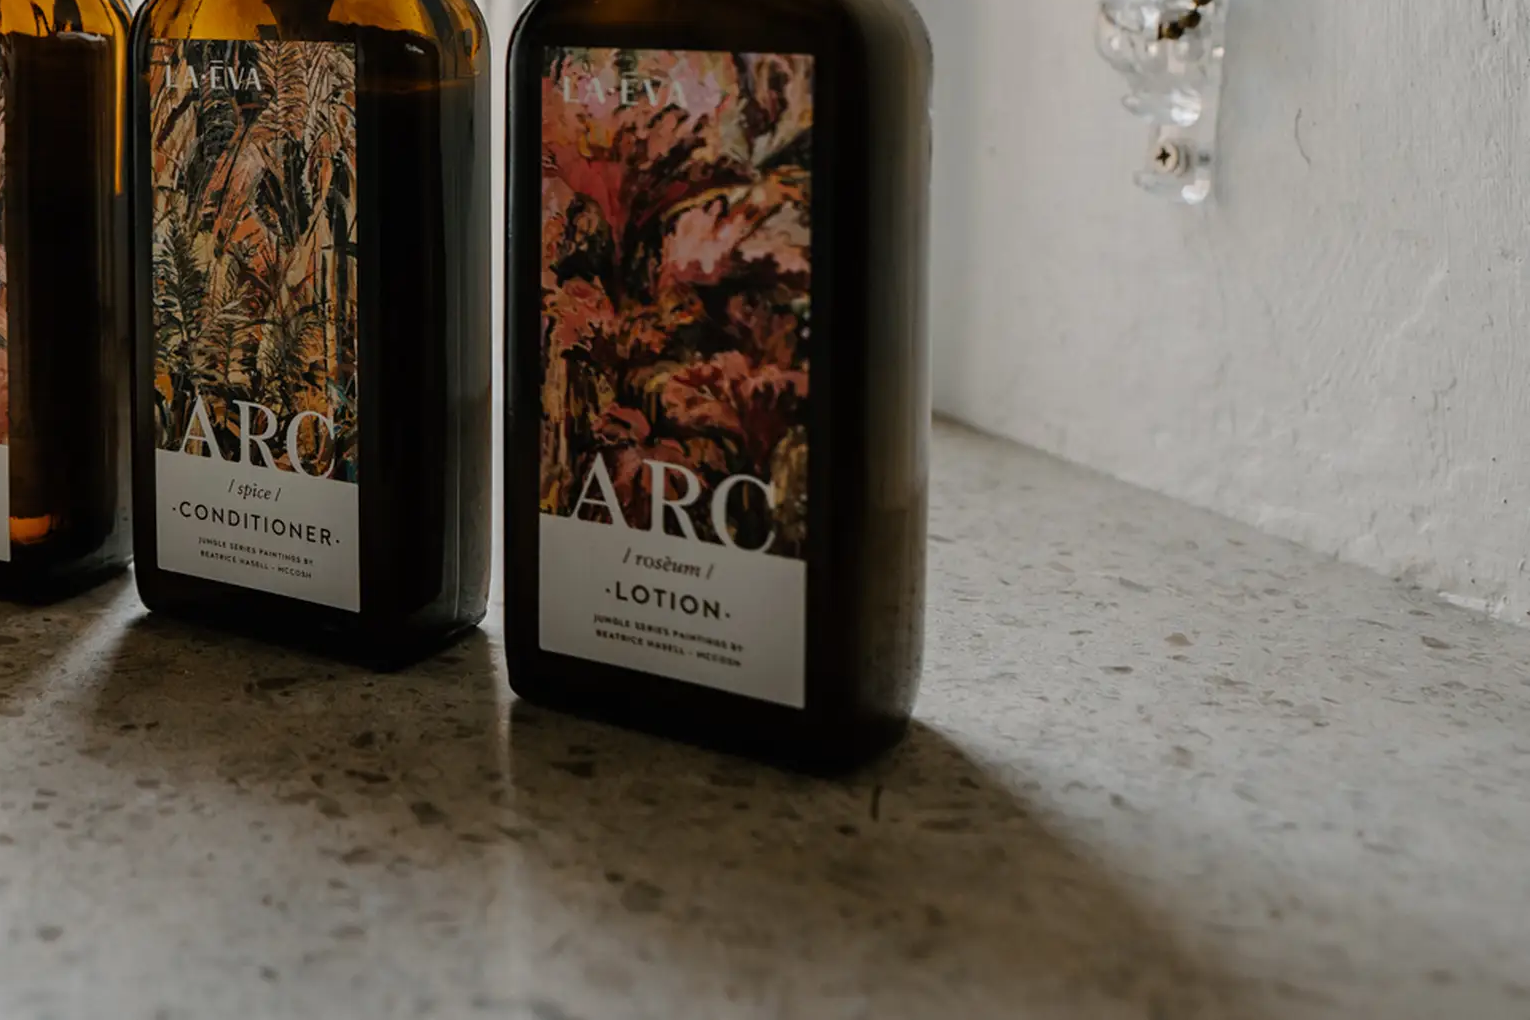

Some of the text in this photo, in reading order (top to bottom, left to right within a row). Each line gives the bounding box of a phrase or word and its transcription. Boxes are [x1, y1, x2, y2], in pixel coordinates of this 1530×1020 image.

[178, 394, 336, 479] ARC
[237, 482, 272, 500] spice
[569, 451, 776, 553] ARC
[198, 536, 314, 566] JUNGLE SERIES PAINTINGS BY
[200, 550, 236, 563] BEATRICE
[239, 558, 269, 570] HASELL
[277, 566, 312, 579] MCCOSH
[593, 613, 630, 628] JUNGLE
[634, 621, 669, 637] SERIES
[672, 630, 728, 649] PAINTINGS
[596, 629, 643, 646] BEATRICE
